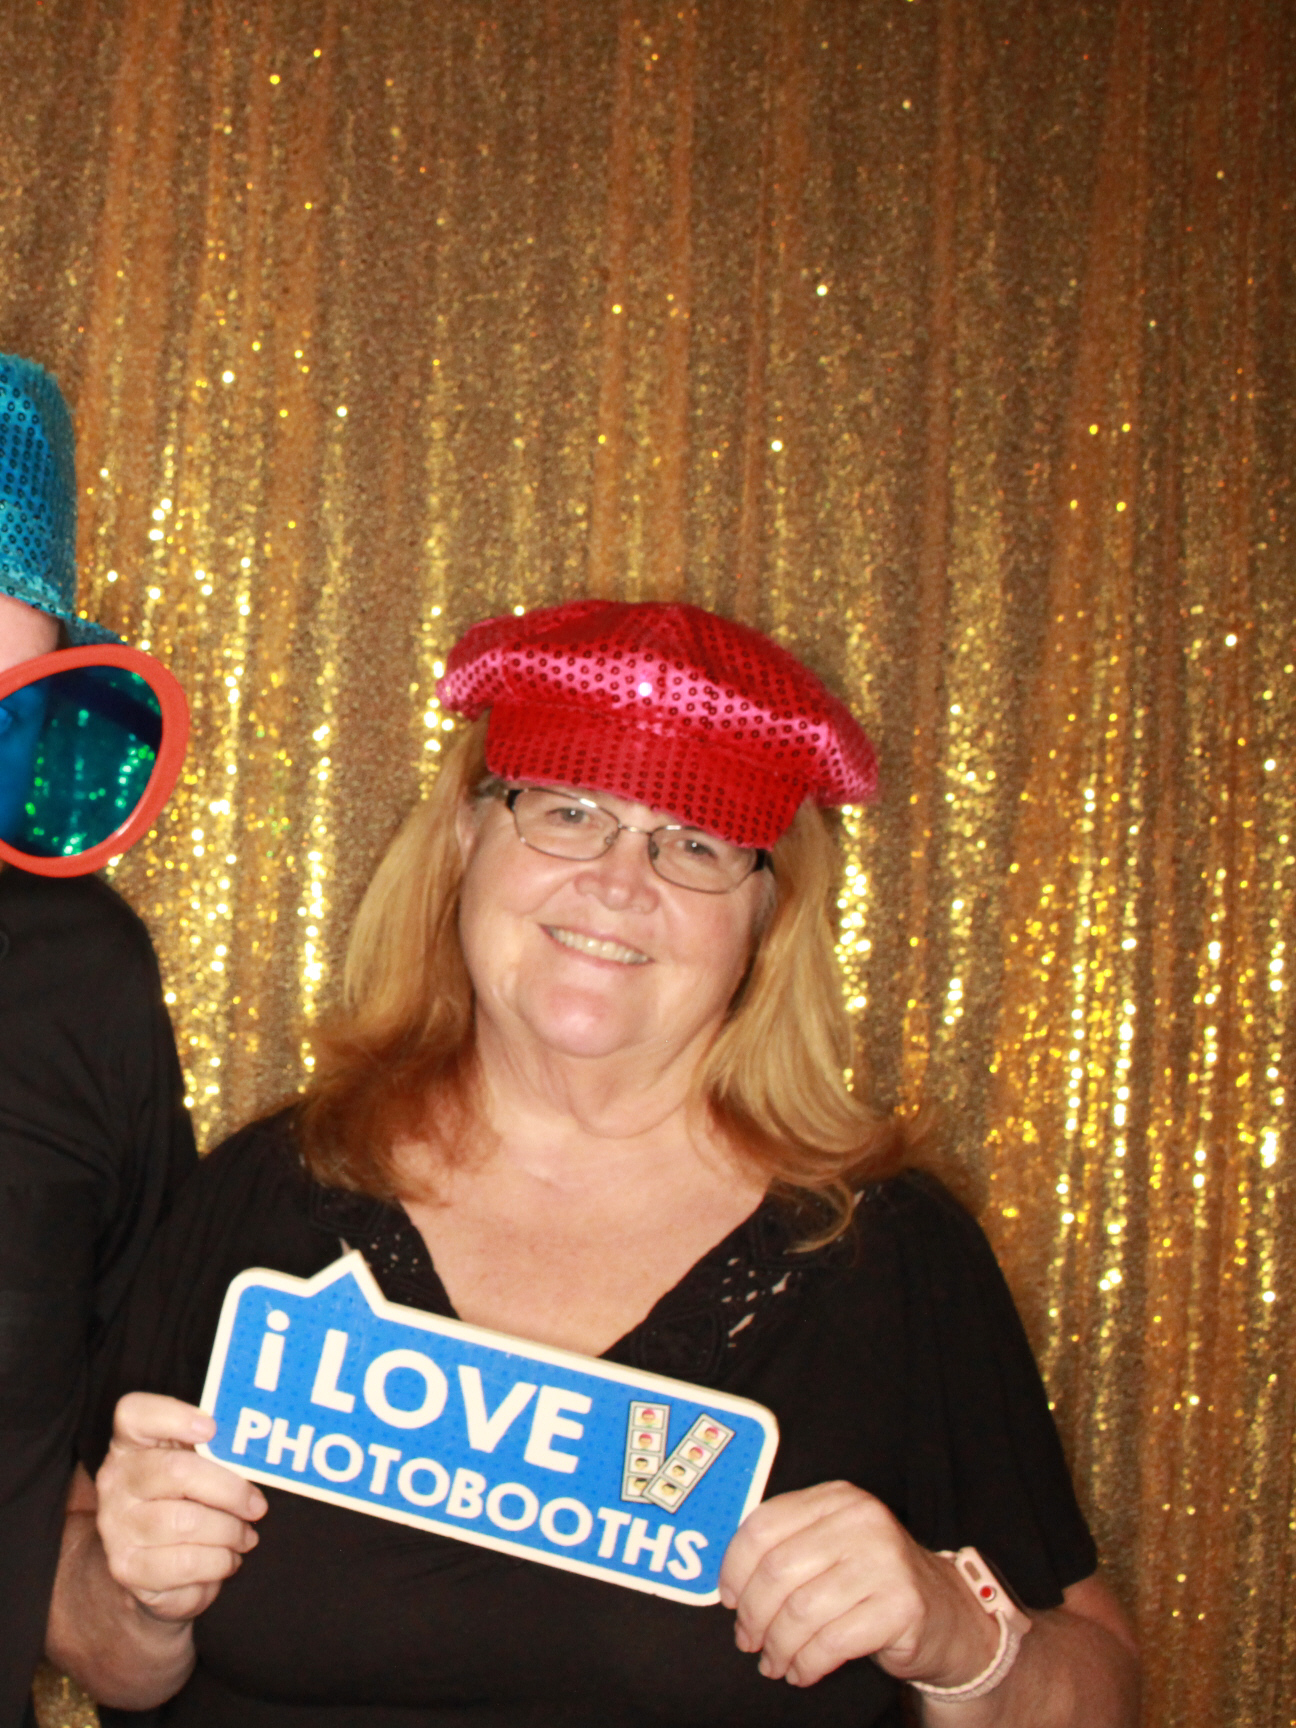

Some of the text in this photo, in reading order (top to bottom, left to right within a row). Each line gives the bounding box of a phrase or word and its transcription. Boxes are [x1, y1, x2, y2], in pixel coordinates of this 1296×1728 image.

[253, 1309, 593, 1474] i LOVE
[231, 1406, 709, 1581] PHOTOBOOTHS
